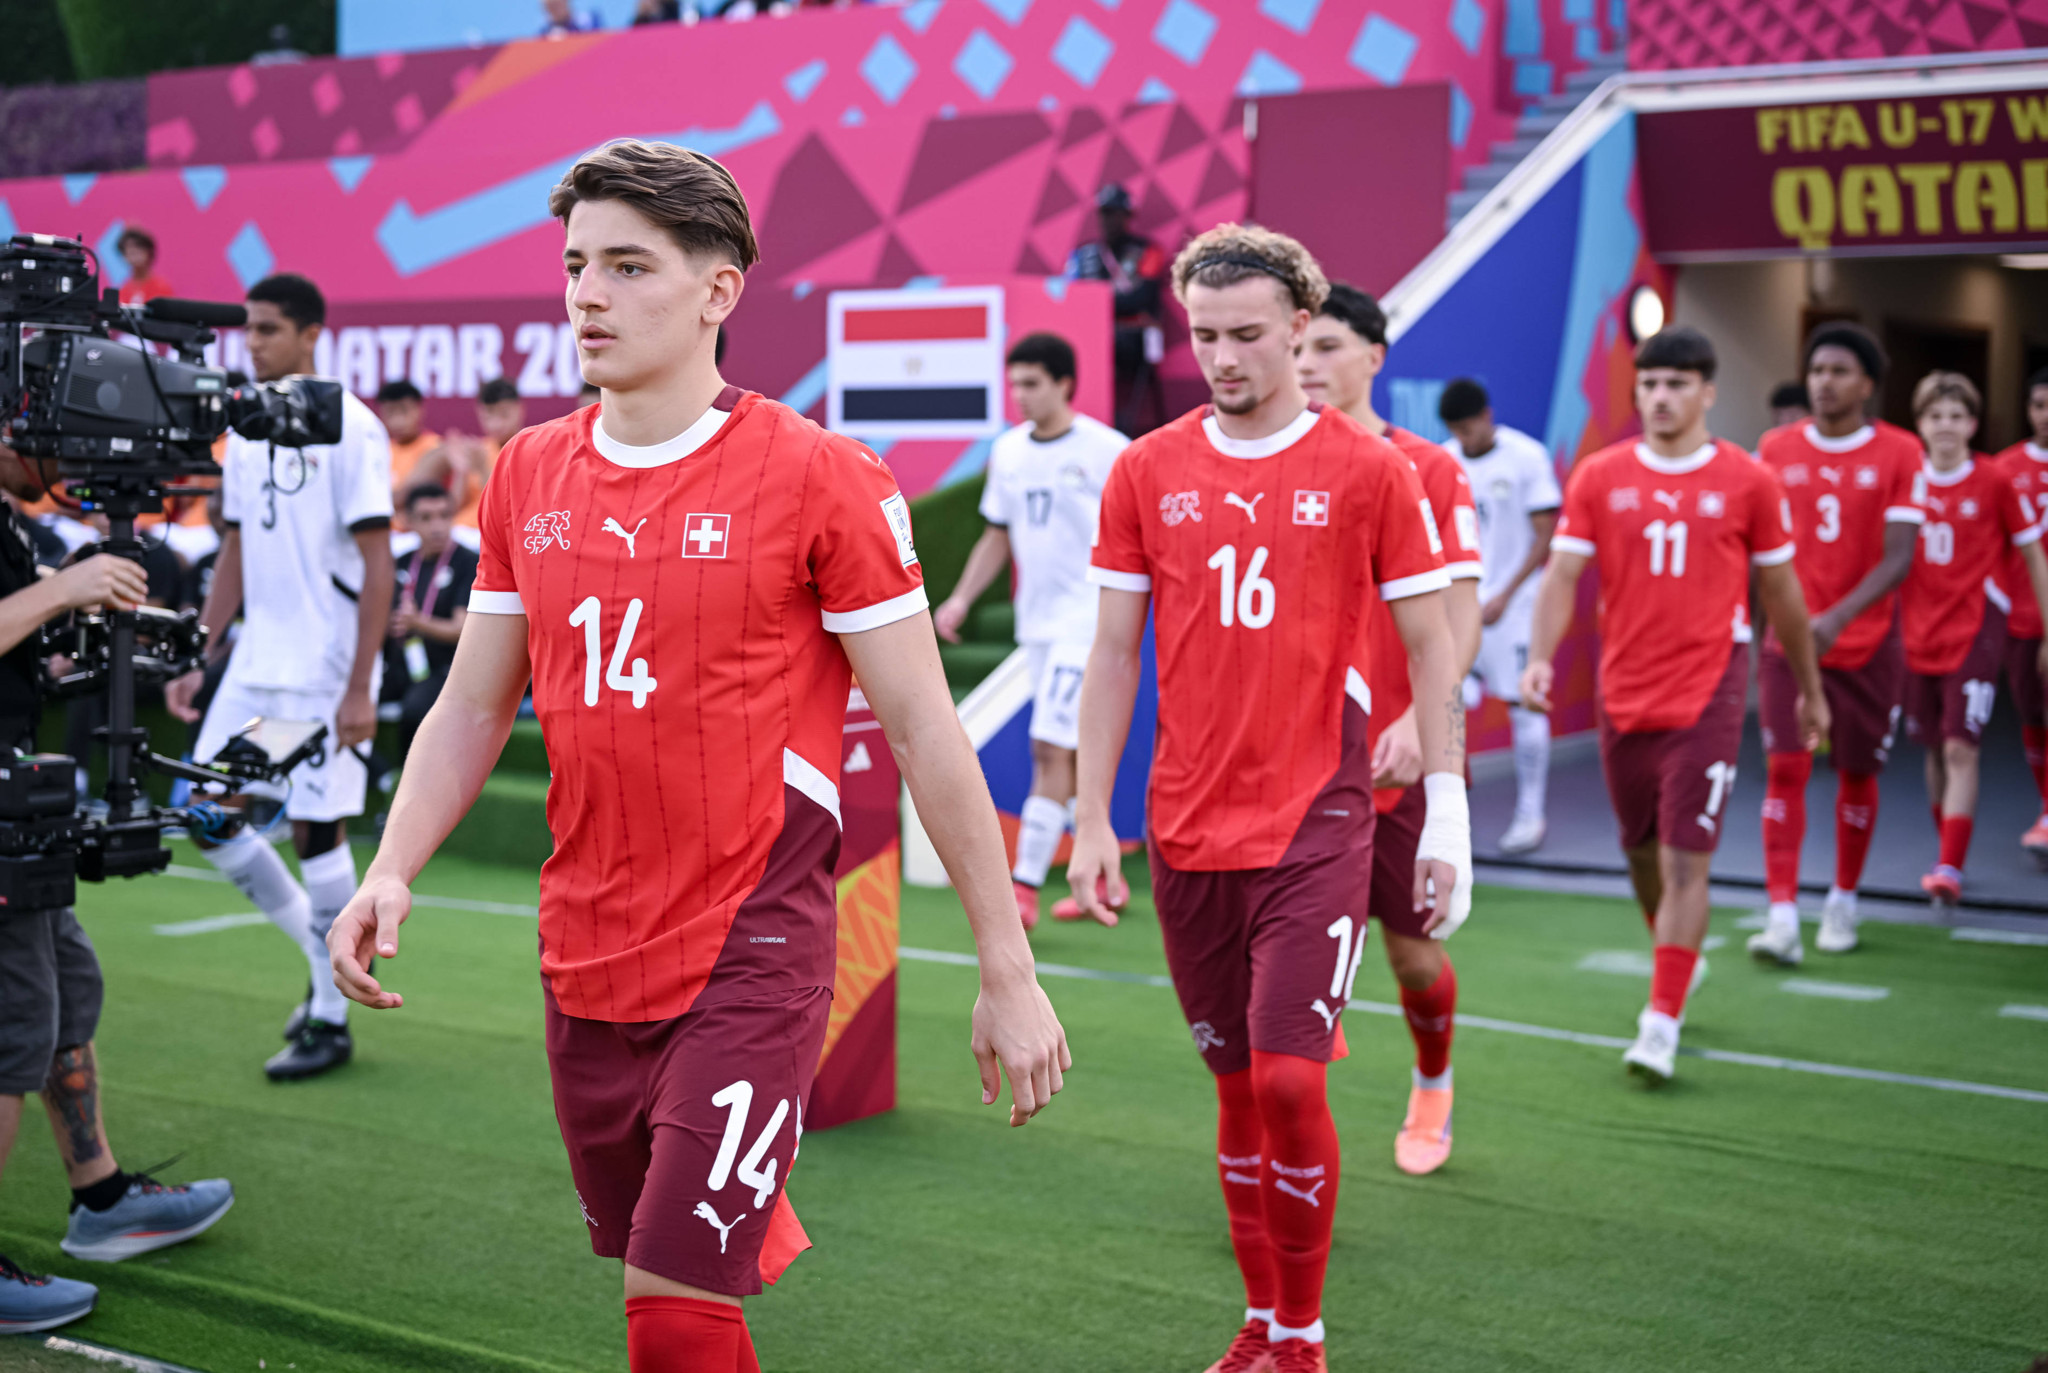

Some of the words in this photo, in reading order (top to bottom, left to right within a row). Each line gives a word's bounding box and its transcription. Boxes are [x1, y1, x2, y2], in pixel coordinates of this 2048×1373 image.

[1757, 105, 1871, 154] FIFA
[1878, 100, 1995, 147] U-17
[1643, 518, 1688, 578] 11
[1816, 493, 1841, 543] 3
[1920, 521, 1954, 566] 10
[1207, 543, 1276, 629] 16
[568, 596, 657, 709] 14
[708, 1080, 789, 1209] 14
